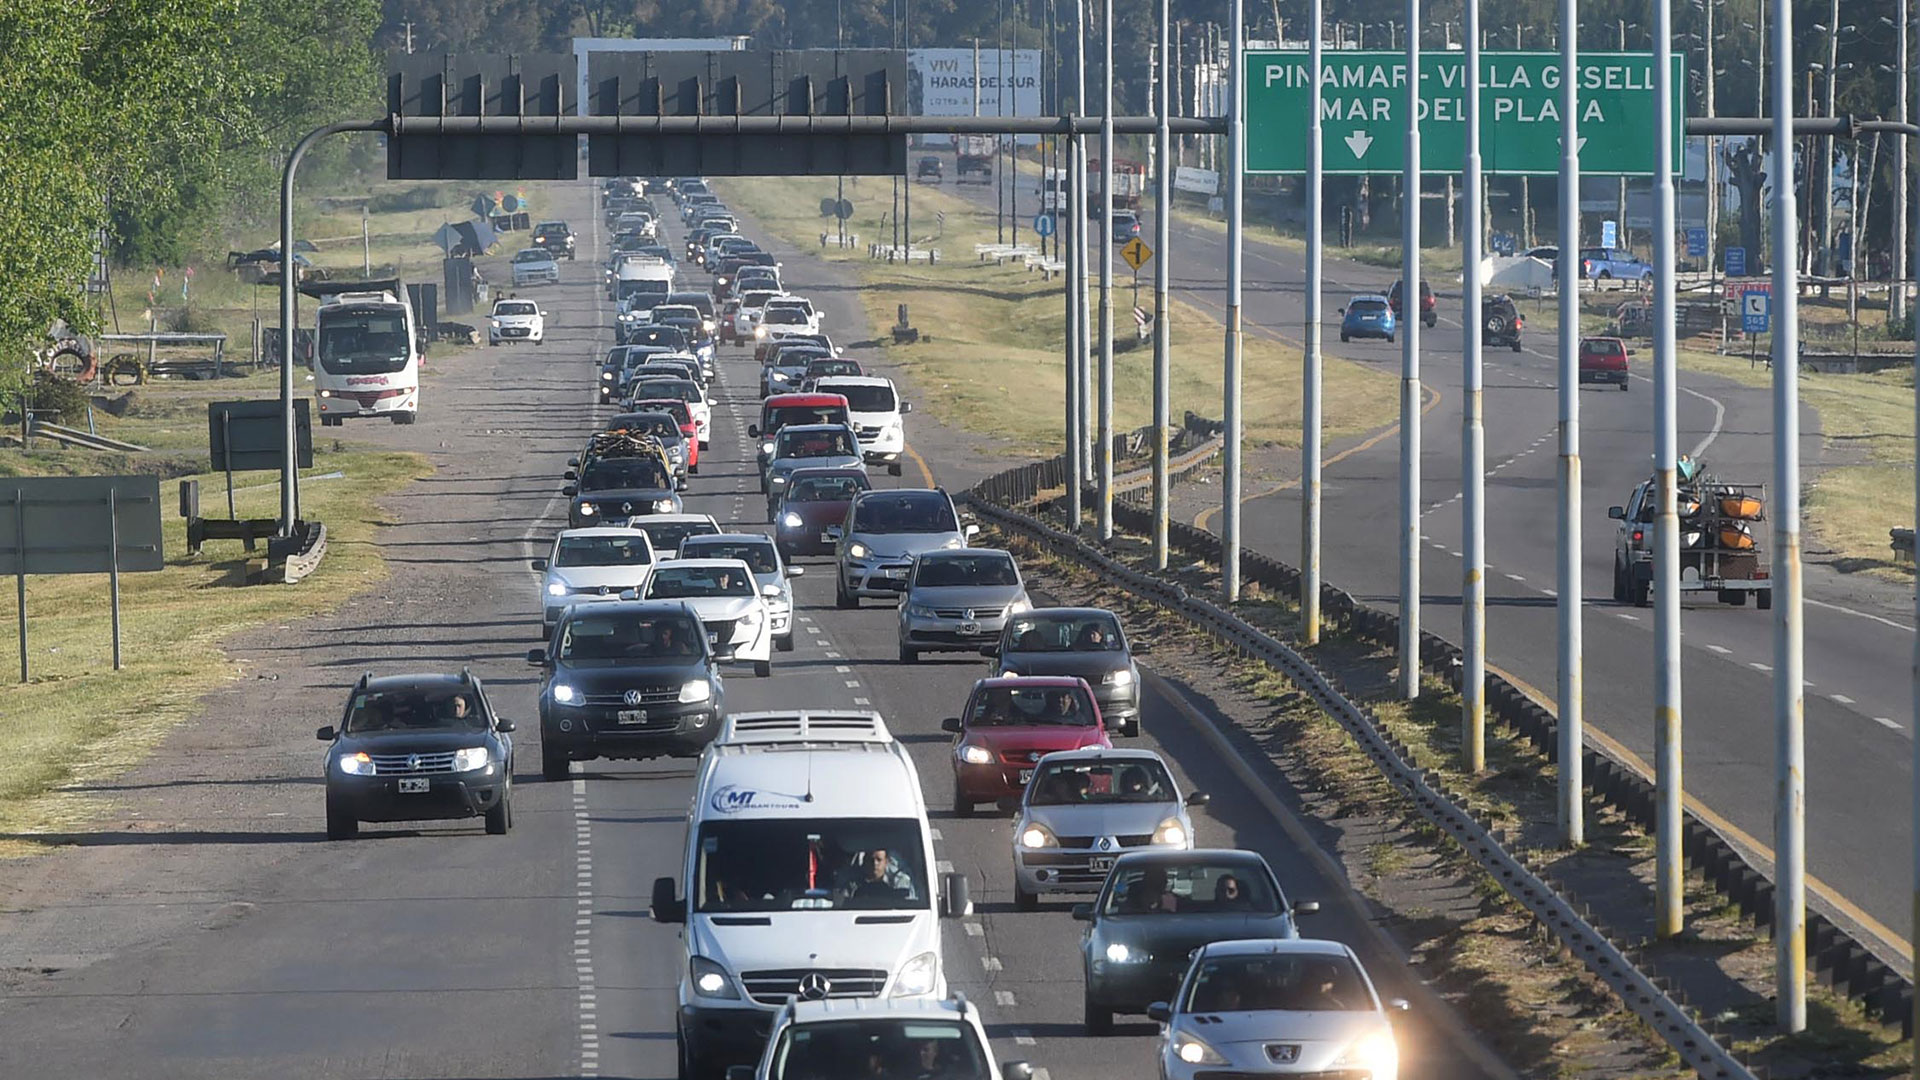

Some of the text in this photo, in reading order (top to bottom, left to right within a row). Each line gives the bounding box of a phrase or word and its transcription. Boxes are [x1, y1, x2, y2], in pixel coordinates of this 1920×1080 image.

[1265, 64, 1407, 89] PINAMAR
[1437, 65, 1532, 89] VILA
[1541, 65, 1655, 90] GSELL
[1321, 98, 1392, 121] MAR
[1495, 98, 1605, 122] PLAA
[727, 791, 756, 803] MT
